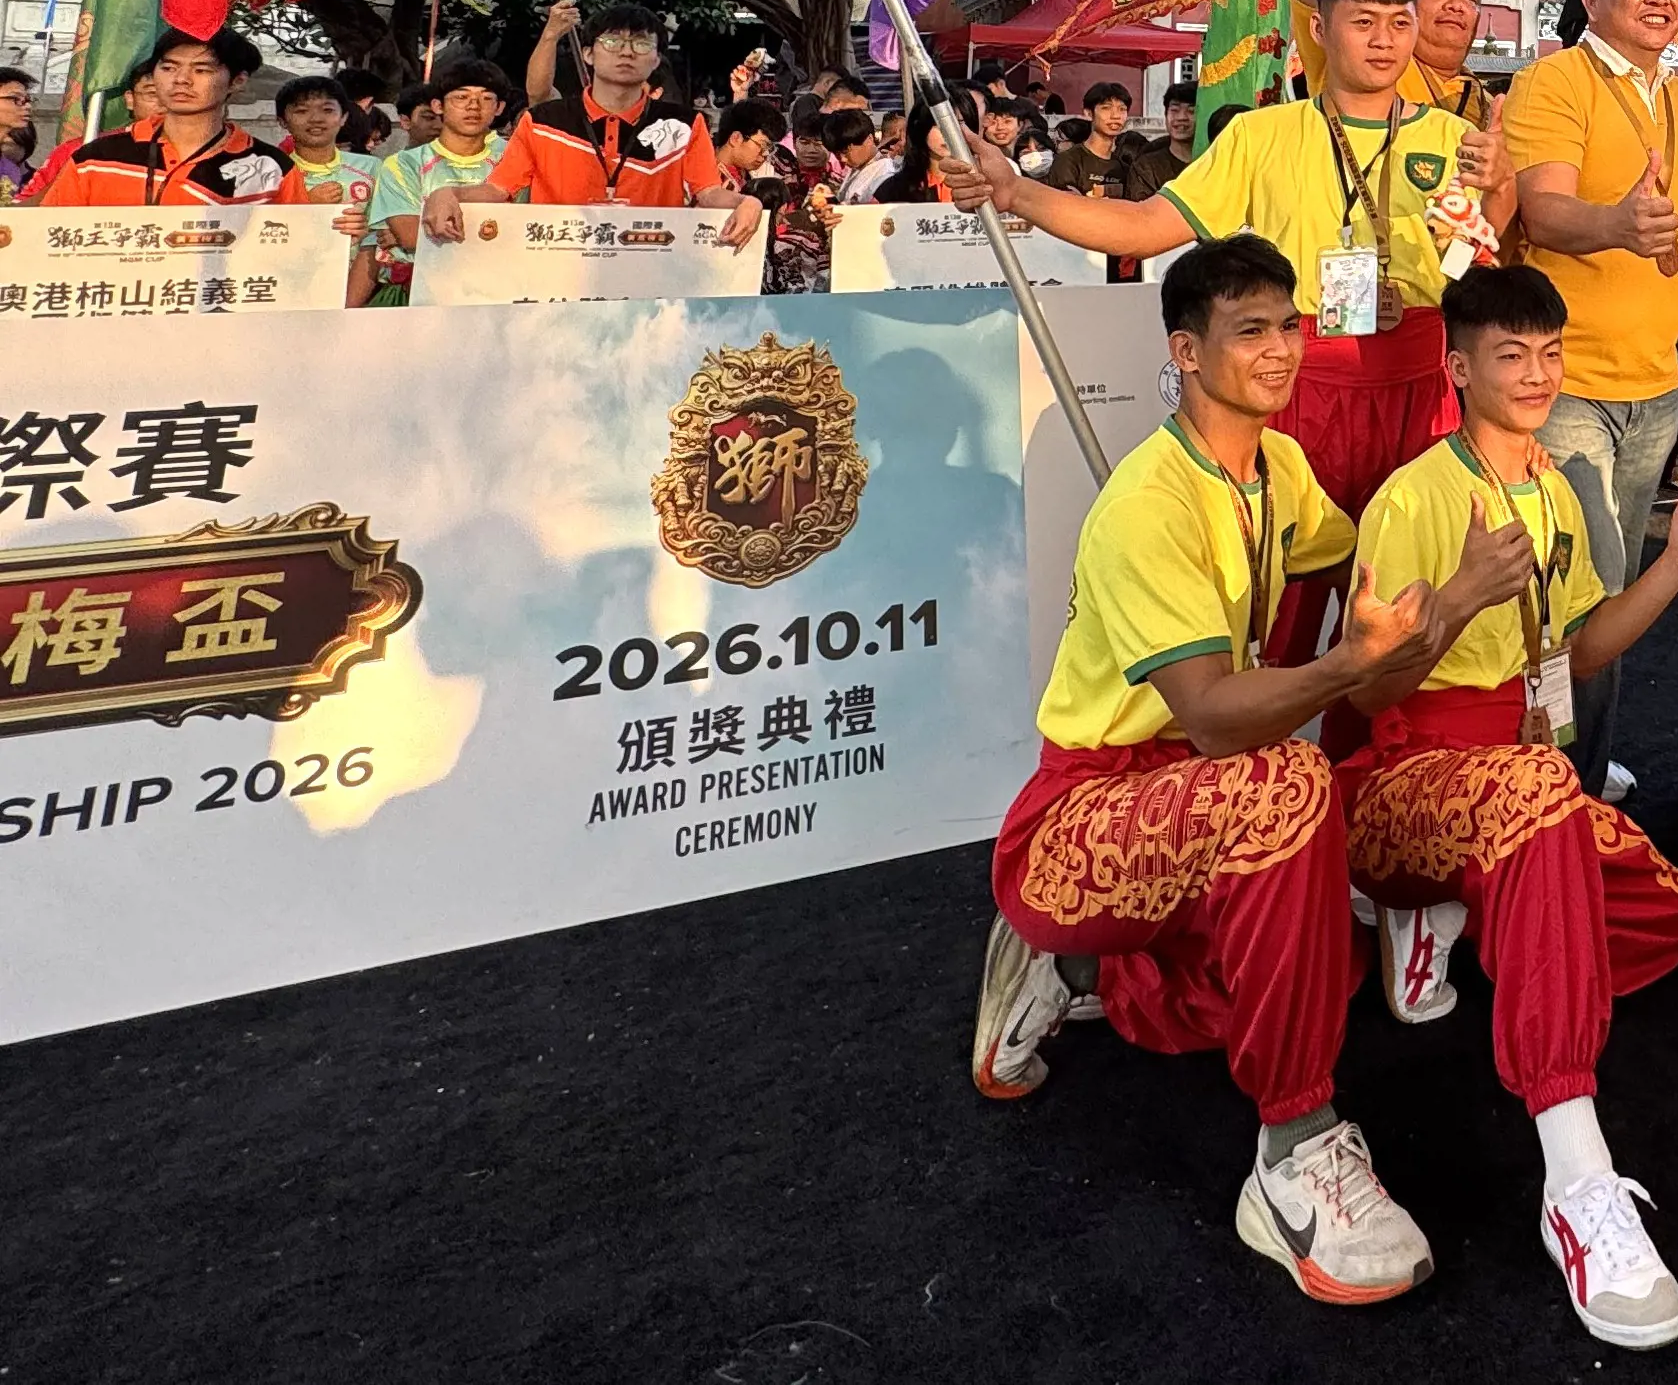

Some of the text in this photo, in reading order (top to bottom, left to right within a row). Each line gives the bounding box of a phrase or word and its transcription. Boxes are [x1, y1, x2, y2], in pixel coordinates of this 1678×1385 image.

[259, 230, 290, 239] MGM
[1, 571, 285, 686] 梅盃
[553, 598, 939, 701] 2026.10.11
[617, 684, 877, 775] 頒獎典禮
[194, 746, 375, 813] 2026
[589, 742, 886, 825] AWARD PRESENTATION
[675, 802, 818, 858] CEREMONY
